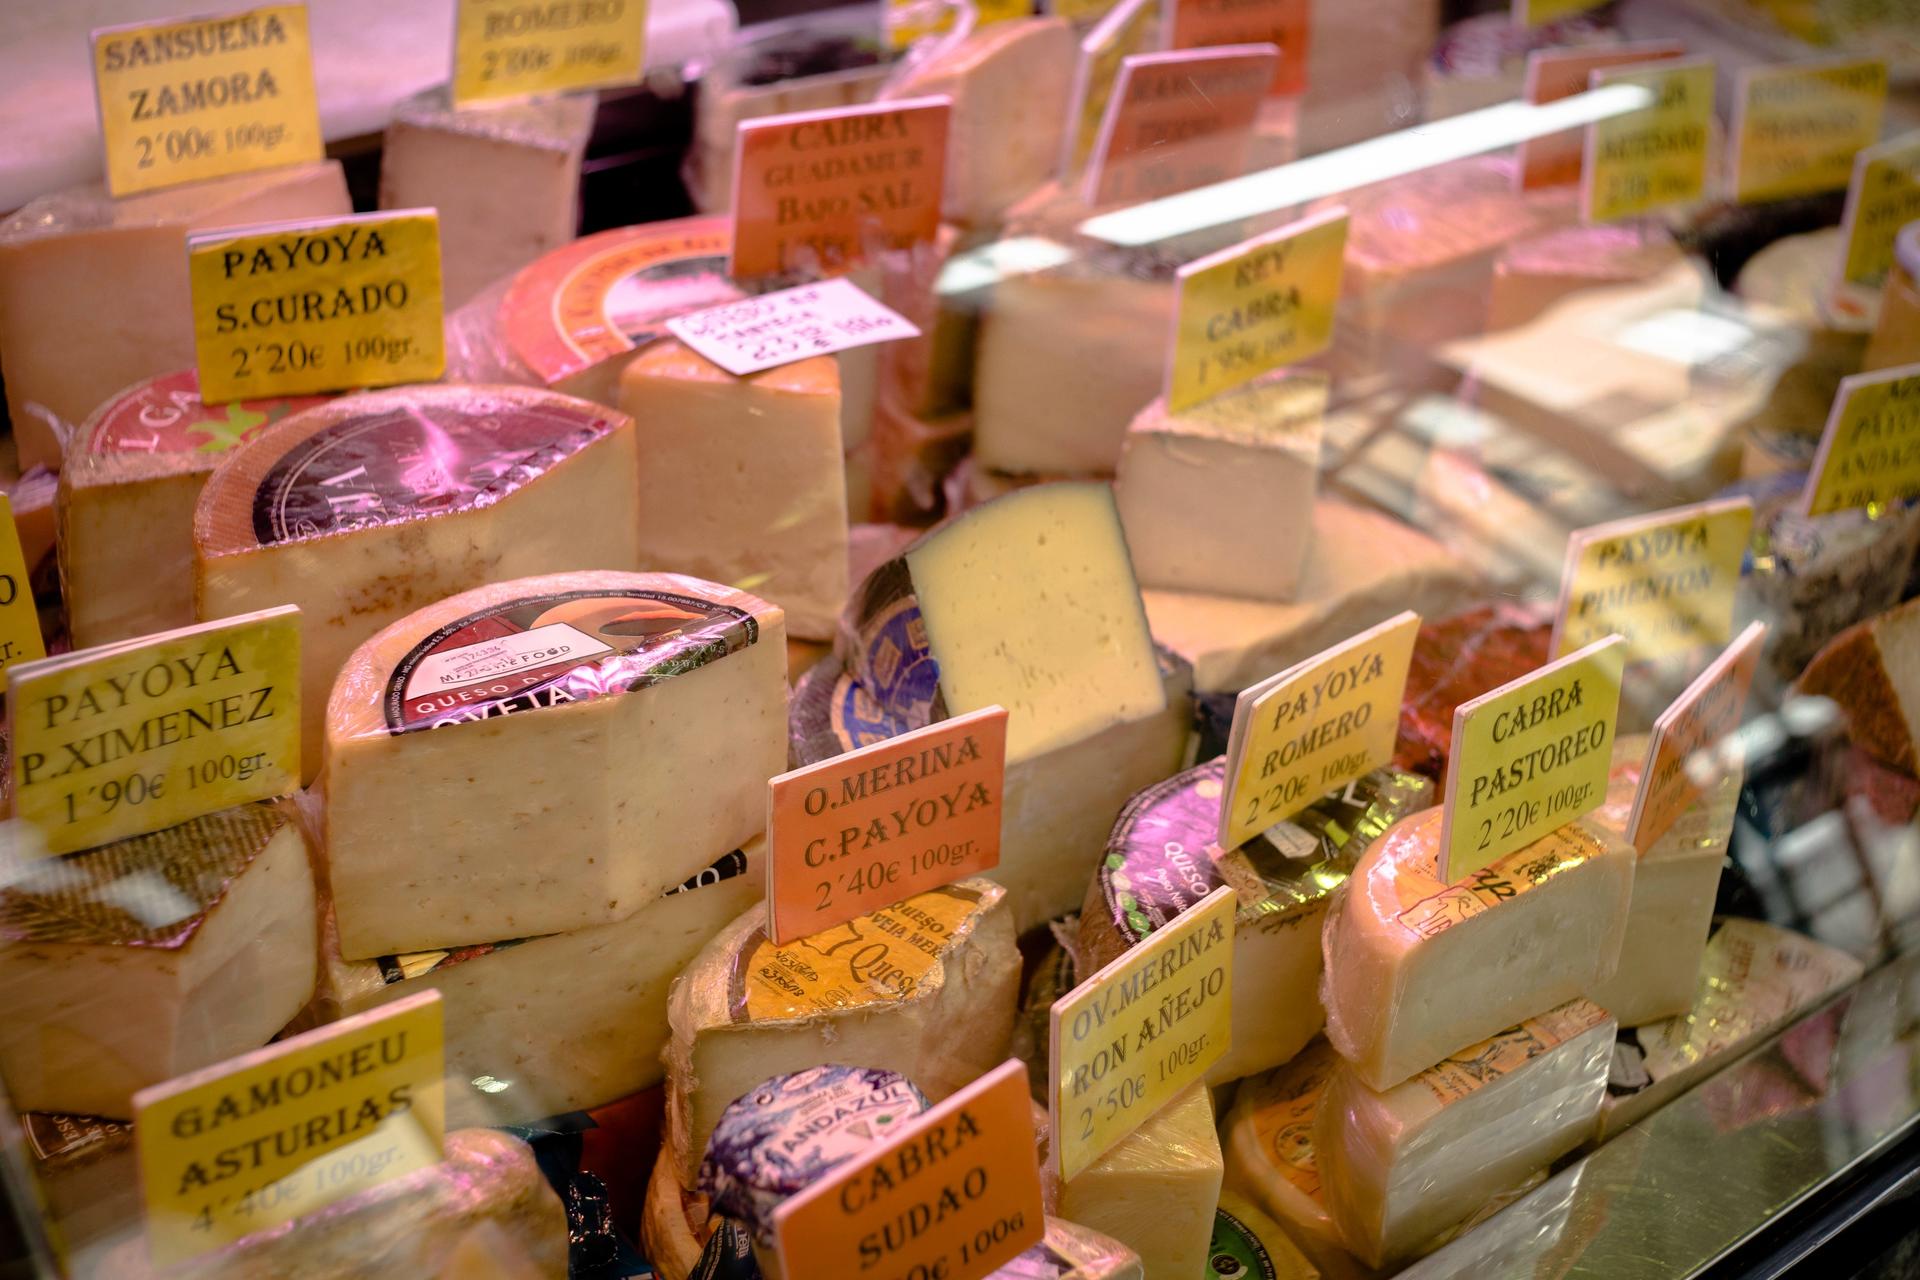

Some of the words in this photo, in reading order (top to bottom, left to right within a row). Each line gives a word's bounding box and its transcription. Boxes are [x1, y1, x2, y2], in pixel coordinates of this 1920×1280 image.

[129, 68, 279, 121] ZAMORA
[223, 228, 387, 278] PAYOYA
[215, 280, 408, 334] S.CURADO
[345, 336, 420, 364] 100gr.
[43, 646, 243, 729] PAYOYA
[415, 684, 509, 714] QUESO
[1273, 653, 1383, 731] PAYOYA
[1492, 679, 1583, 743] CABRA
[19, 686, 274, 786] P.XIMENEZ
[188, 752, 273, 789] 100gr.
[1261, 703, 1372, 780] ROMERO
[1321, 749, 1373, 784] 100gr.
[1470, 720, 1606, 808] PASTOREO
[804, 735, 982, 816] O.MERINA
[1546, 781, 1594, 817] 100gr.
[804, 782, 992, 868] C.PAYOYA
[911, 839, 980, 875] 100gr.
[1164, 842, 1210, 896] QUESO
[1072, 916, 1224, 1042] OV.MERINA
[1072, 1033, 1128, 1098] RON
[1136, 967, 1225, 1052] AÑEJO
[1159, 1031, 1210, 1081] 100gr.
[170, 1032, 408, 1138] GAMONEU
[178, 1084, 414, 1196] ASTURIAS
[315, 1146, 404, 1190] 100gr.
[840, 1110, 981, 1215] CABRA
[858, 1167, 987, 1273] SUDAO
